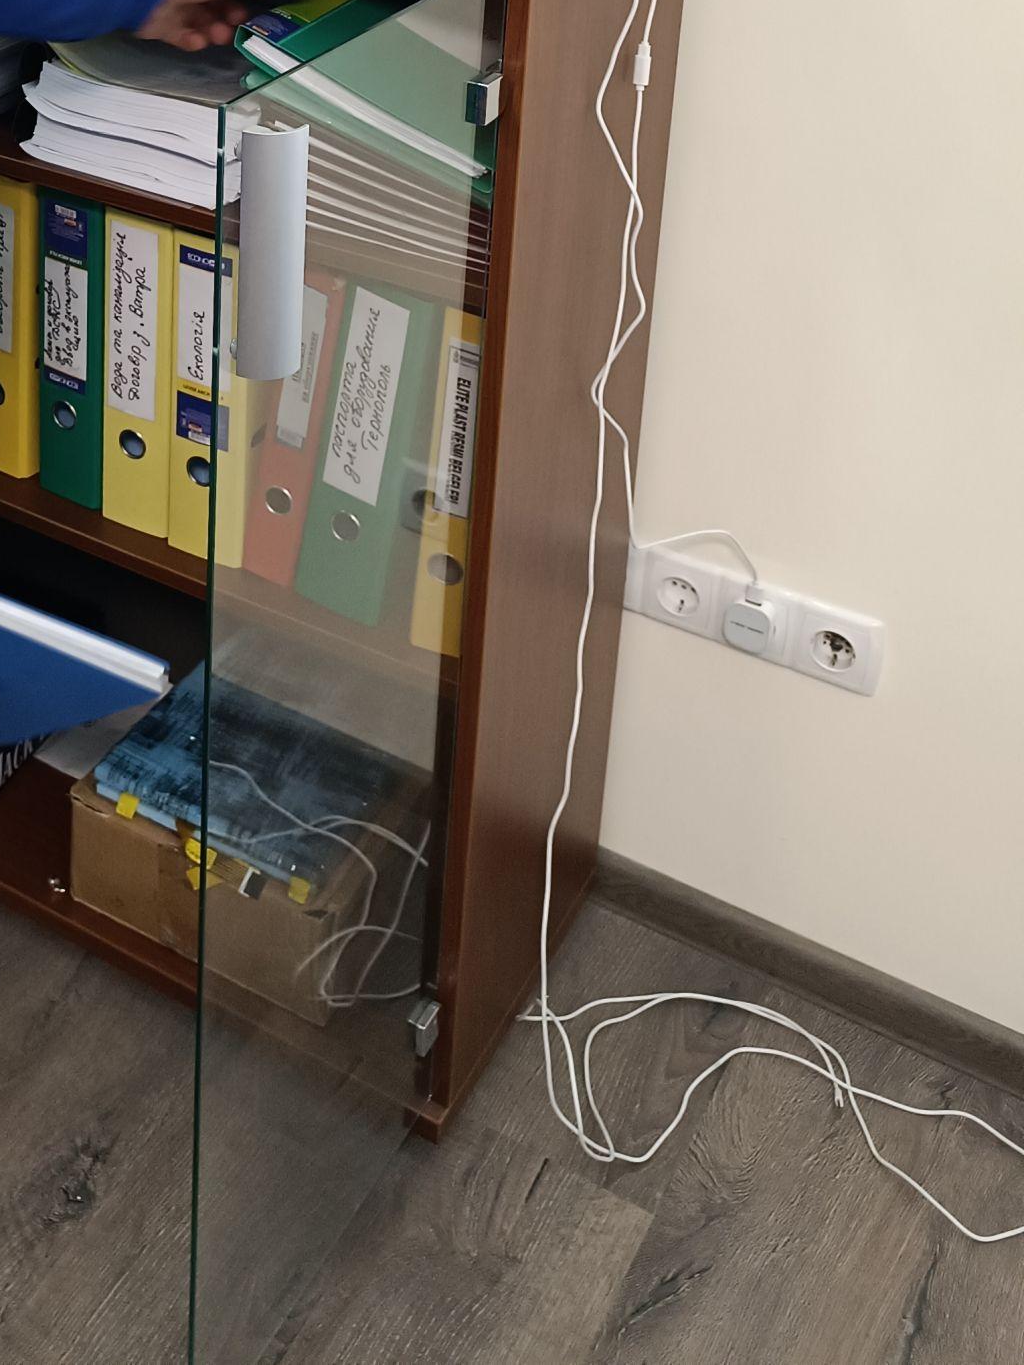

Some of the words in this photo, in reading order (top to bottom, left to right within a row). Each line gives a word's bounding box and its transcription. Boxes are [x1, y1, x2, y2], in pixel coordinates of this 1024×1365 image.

[113, 233, 132, 323] каналізація
[114, 329, 122, 354] та
[187, 311, 205, 381] Екологія
[351, 307, 380, 429] оборудования
[111, 362, 128, 399] Вода
[128, 345, 147, 401] Договір
[456, 377, 471, 404] ELITE
[332, 361, 356, 458] паспорта
[361, 364, 391, 451] Тернополь
[454, 402, 469, 432] PLAST
[343, 440, 360, 484] для
